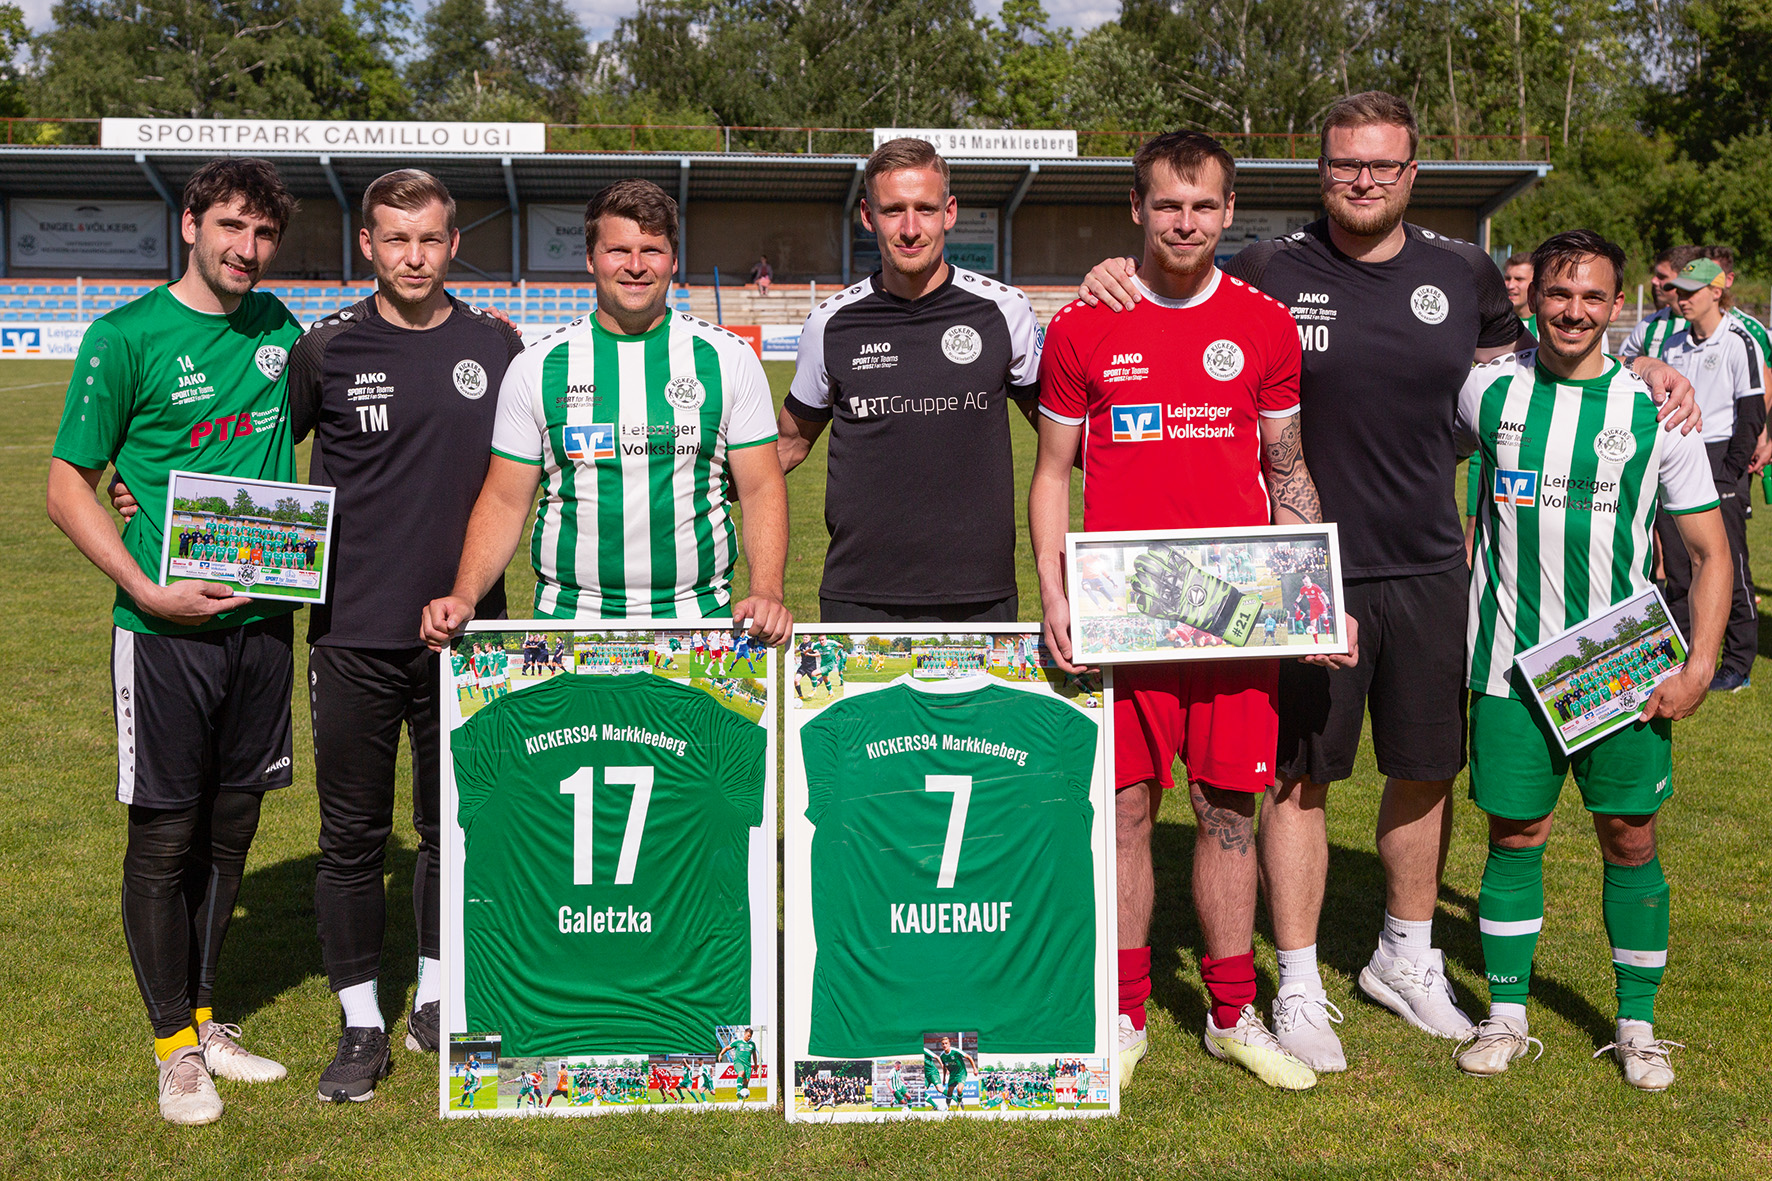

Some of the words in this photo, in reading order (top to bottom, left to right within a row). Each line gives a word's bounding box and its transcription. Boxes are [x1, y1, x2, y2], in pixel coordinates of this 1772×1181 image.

[138, 124, 311, 144] SPORTPARK
[324, 126, 449, 146] CAMILLO
[463, 128, 511, 146] UGI
[971, 135, 1075, 153] Markkleeberg
[556, 226, 585, 235] ENGE
[1297, 293, 1329, 304] JAKO
[1417, 288, 1441, 298] KICKERS
[47, 327, 84, 339] Leipzi
[948, 328, 974, 337] KICKERS
[1297, 325, 1328, 352] MO
[47, 343, 79, 353] Volks
[860, 342, 891, 355] JAKO
[953, 338, 970, 350] 94
[1211, 343, 1238, 353] KICKERS
[177, 355, 194, 372] 14
[852, 356, 870, 366] SPORT
[1111, 353, 1143, 365] JAKO
[1215, 353, 1232, 367] 94
[459, 363, 481, 373] KICKERS
[178, 372, 206, 387] JAKO
[355, 372, 386, 385] JAKO
[672, 378, 698, 387] KICKERS
[347, 387, 366, 396] SPORT
[565, 384, 596, 394] JAKO
[676, 388, 693, 399] 94
[867, 395, 958, 416] RT.Gruppe
[964, 392, 988, 410] AG
[356, 404, 389, 432] TM
[1167, 403, 1232, 421] Leipziger
[190, 412, 254, 448] PTB
[622, 421, 696, 438] Leipziger
[1167, 423, 1235, 439] Volksbank
[1497, 421, 1526, 432] JAKO
[1604, 429, 1631, 440] KICKERS
[622, 441, 703, 456] Volksbank
[1544, 474, 1616, 494] Leipziger
[1542, 494, 1621, 513] Volksbank
[1232, 612, 1251, 637] #21
[525, 724, 598, 755] KICKERS94
[602, 724, 687, 757] Markkleeberg
[865, 734, 938, 760] KICKERS94
[942, 734, 1029, 767] Markkleeberg
[1255, 762, 1267, 773] JA
[559, 766, 655, 885] 17
[925, 774, 973, 889] 7
[558, 905, 652, 934] Galetzka
[890, 901, 1012, 934] KAUERAUF
